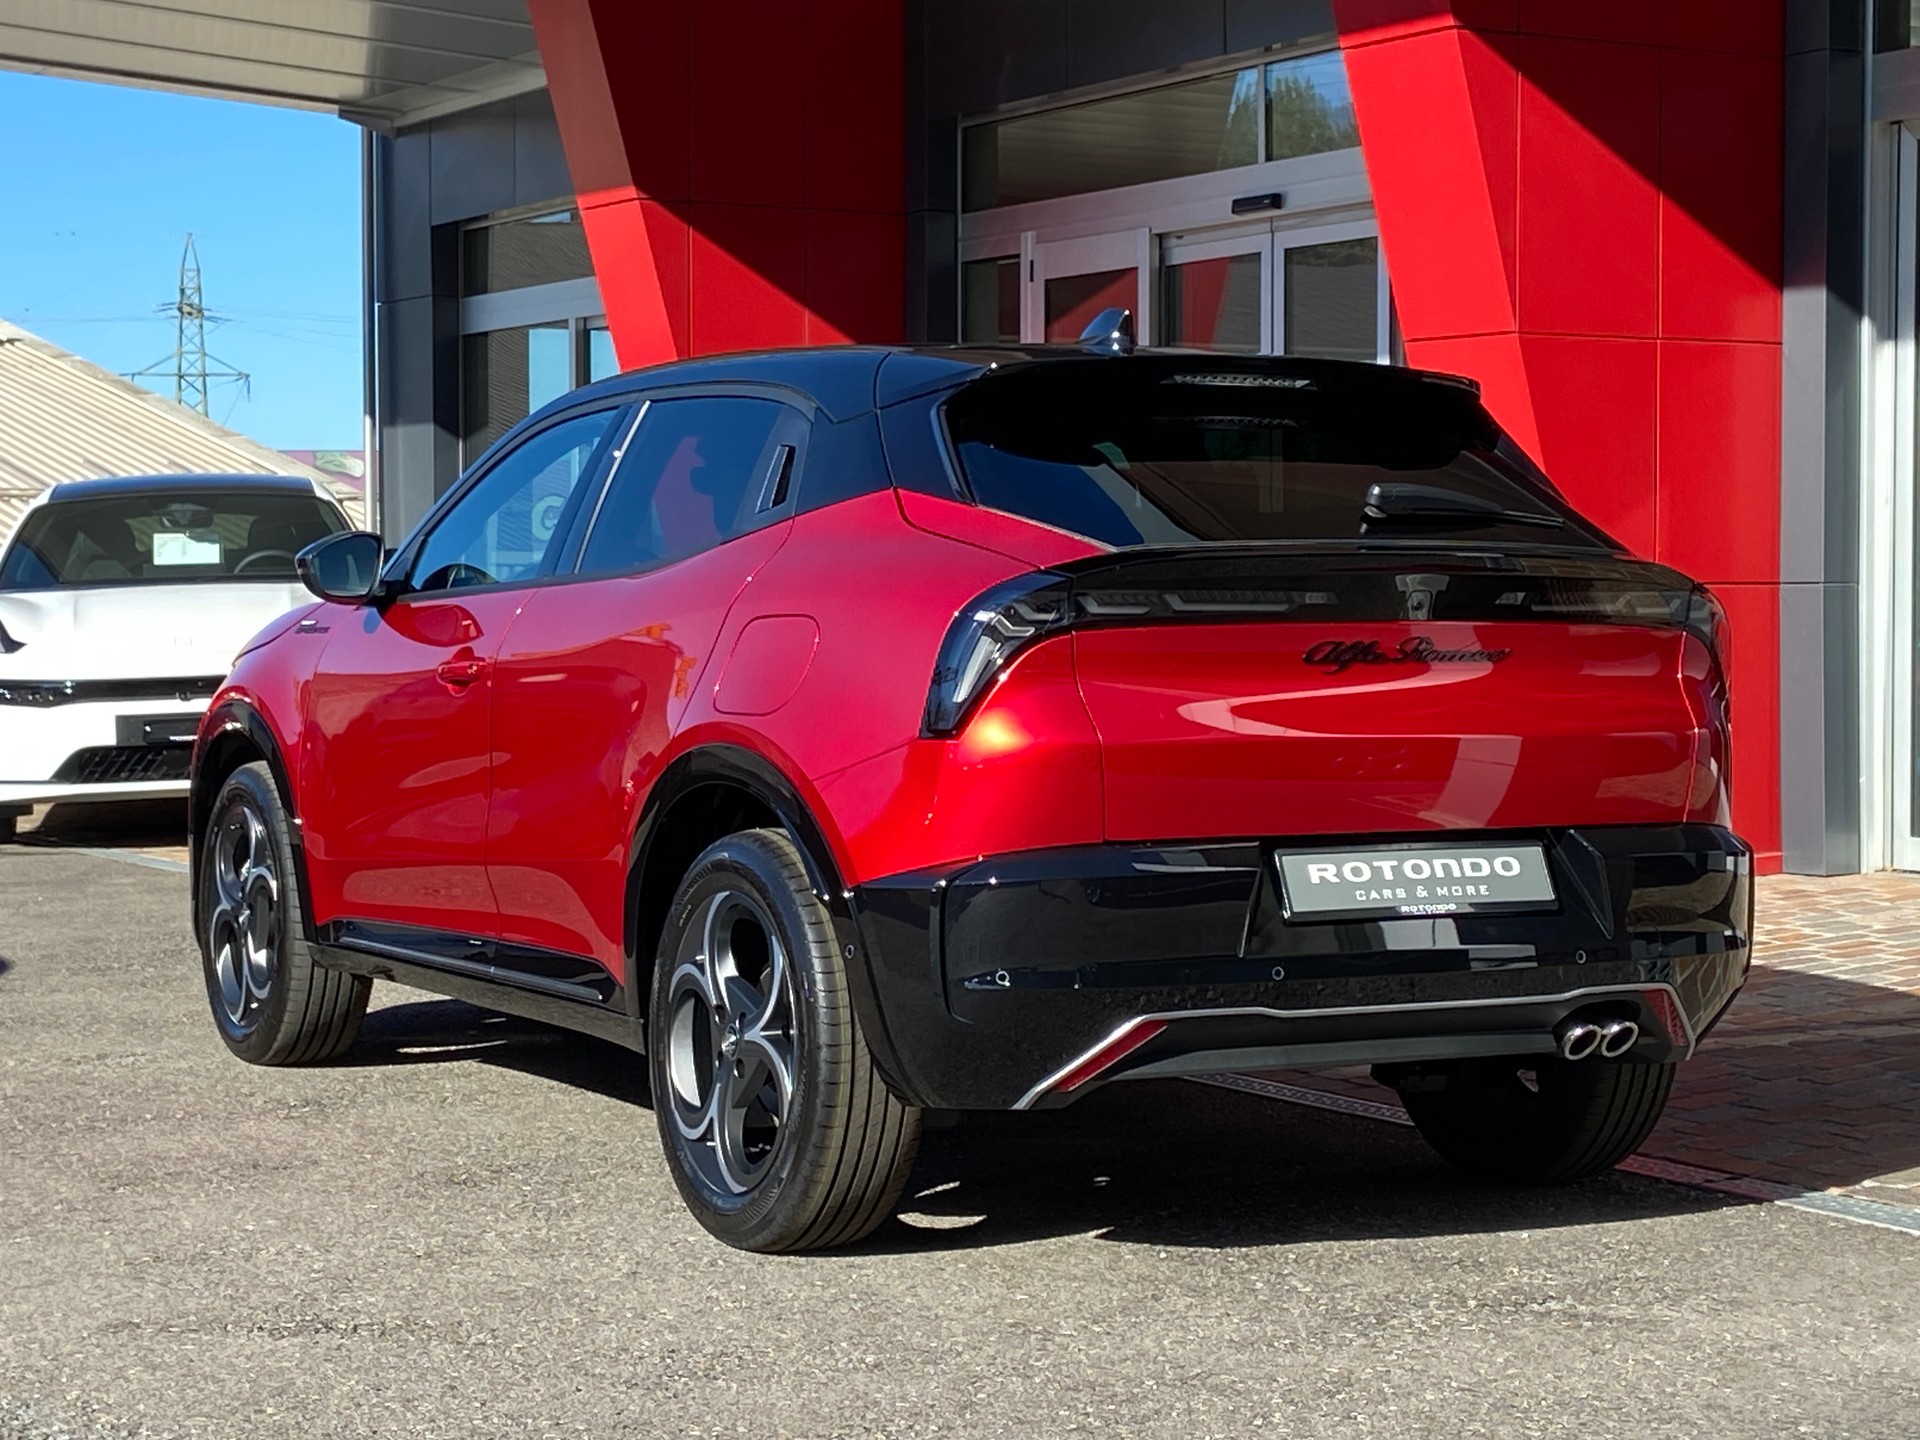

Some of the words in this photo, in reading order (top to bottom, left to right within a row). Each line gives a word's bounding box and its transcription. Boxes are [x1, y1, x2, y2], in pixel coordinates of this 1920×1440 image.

[1303, 639, 1388, 675] Alfa
[1389, 636, 1513, 663] Romeo
[1307, 856, 1521, 884] ROTONDO
[1355, 887, 1407, 901] CARS
[1415, 885, 1429, 898] &
[1437, 884, 1490, 897] MORE
[1400, 902, 1458, 913] ROTONDO
